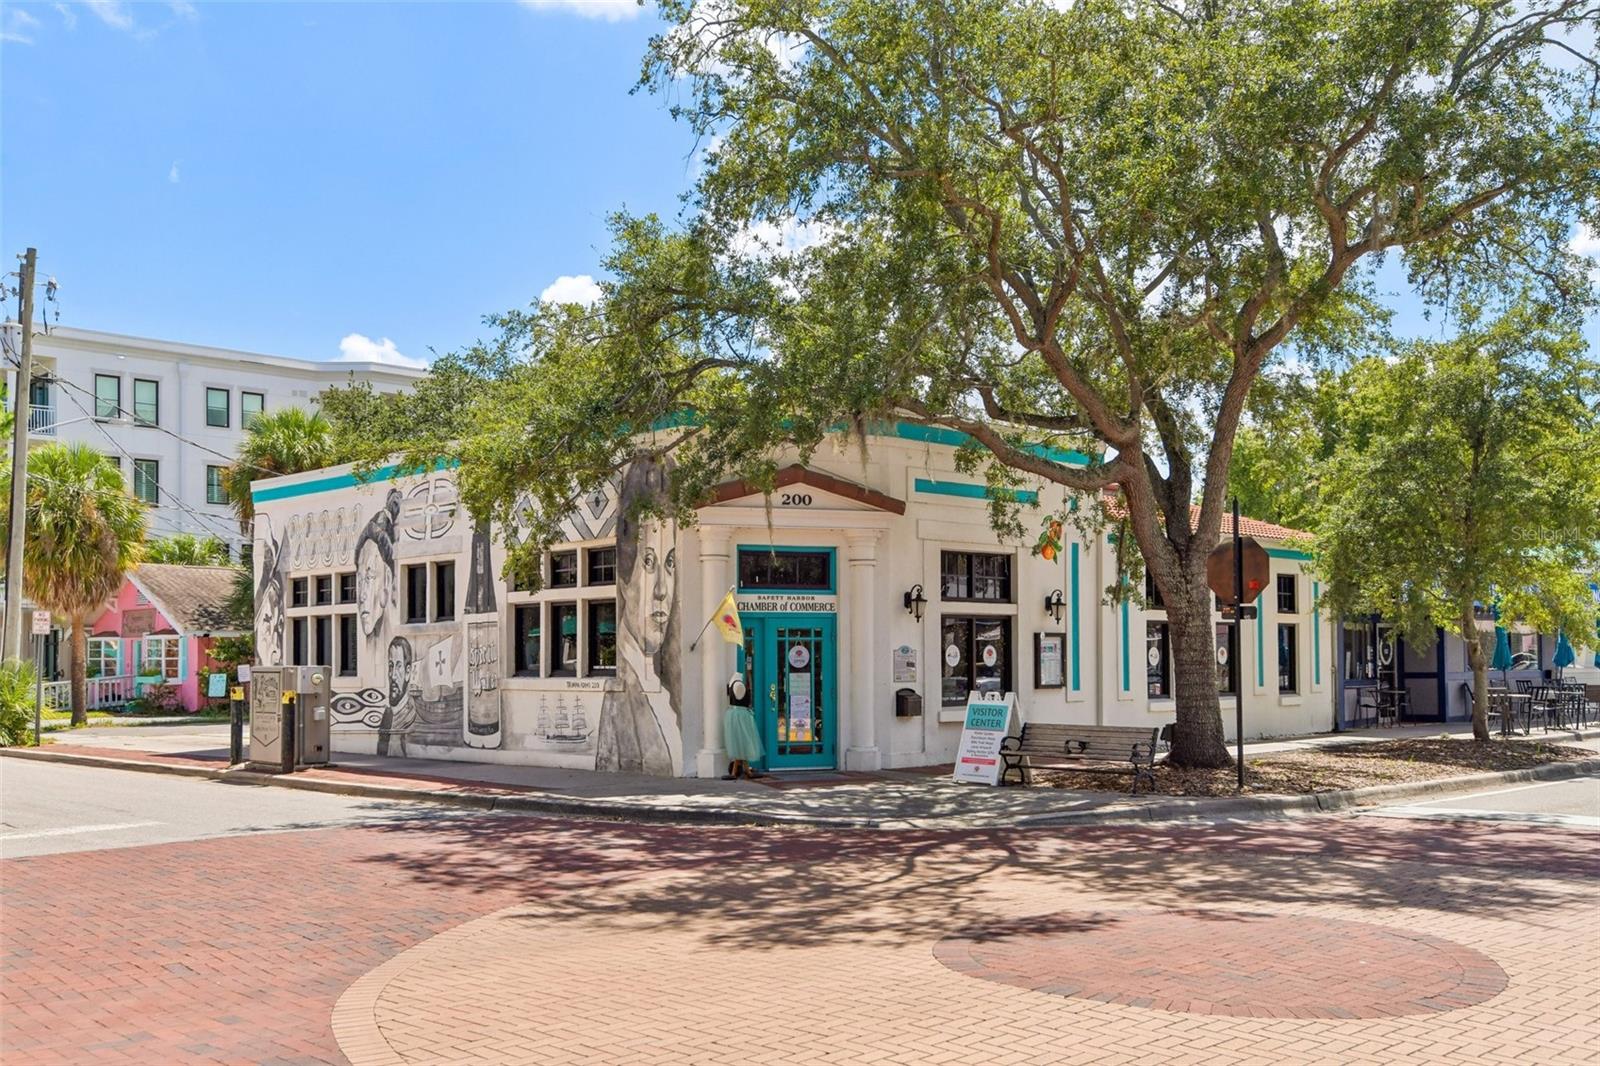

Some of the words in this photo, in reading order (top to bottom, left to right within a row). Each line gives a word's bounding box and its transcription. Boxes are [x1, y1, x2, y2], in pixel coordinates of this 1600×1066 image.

[781, 493, 812, 506] 200
[737, 601, 778, 611] CHAMBER
[780, 602, 788, 611] of
[789, 602, 835, 612] COMMERCE
[971, 707, 1004, 718] VISITOR
[970, 718, 1002, 728] CENTER
